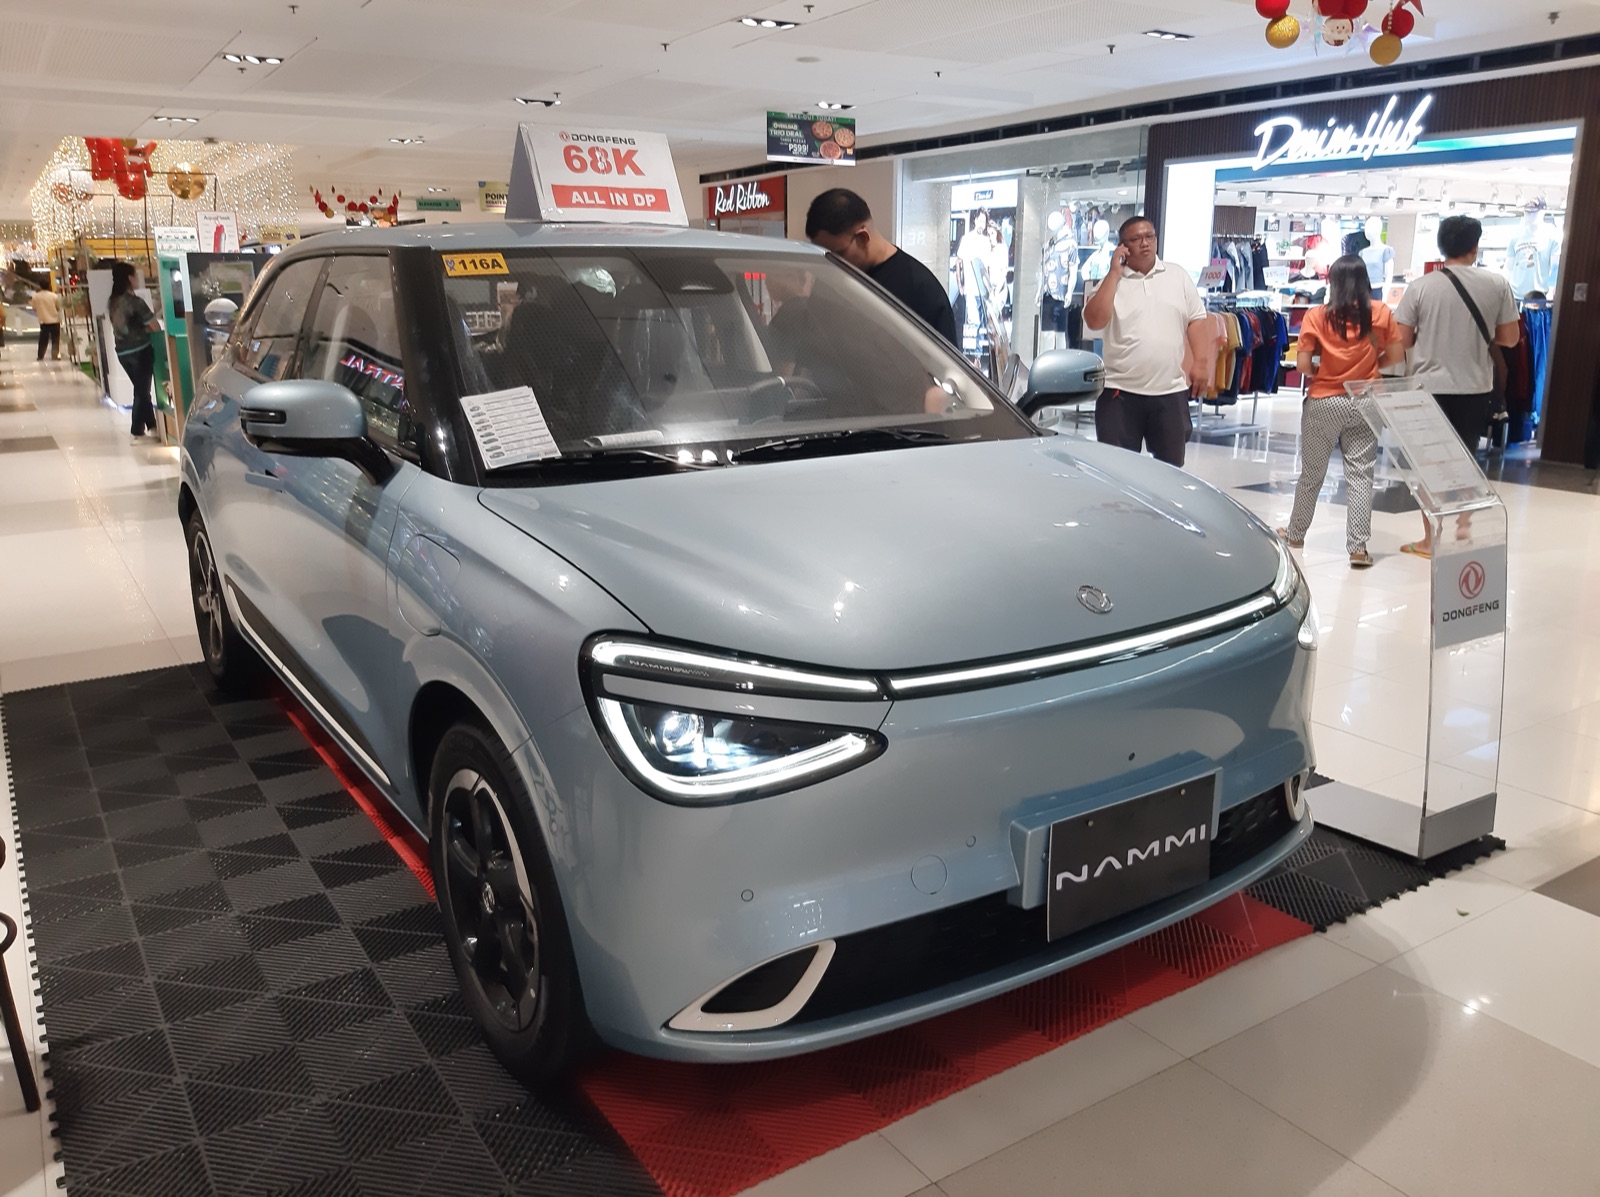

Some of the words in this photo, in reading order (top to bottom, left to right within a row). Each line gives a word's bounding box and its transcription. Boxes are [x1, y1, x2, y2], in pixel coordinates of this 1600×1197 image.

[571, 133, 636, 145] DONGFENG
[786, 130, 803, 138] DEAL
[563, 144, 646, 177] 68K
[571, 191, 606, 205] ALL
[610, 192, 629, 206] IN
[632, 194, 656, 207] DP
[714, 184, 735, 216] Red
[736, 181, 770, 214] Ribbon
[458, 258, 503, 270] 116A
[1442, 600, 1499, 622] DONGFENG
[1055, 823, 1206, 891] NAMMI
